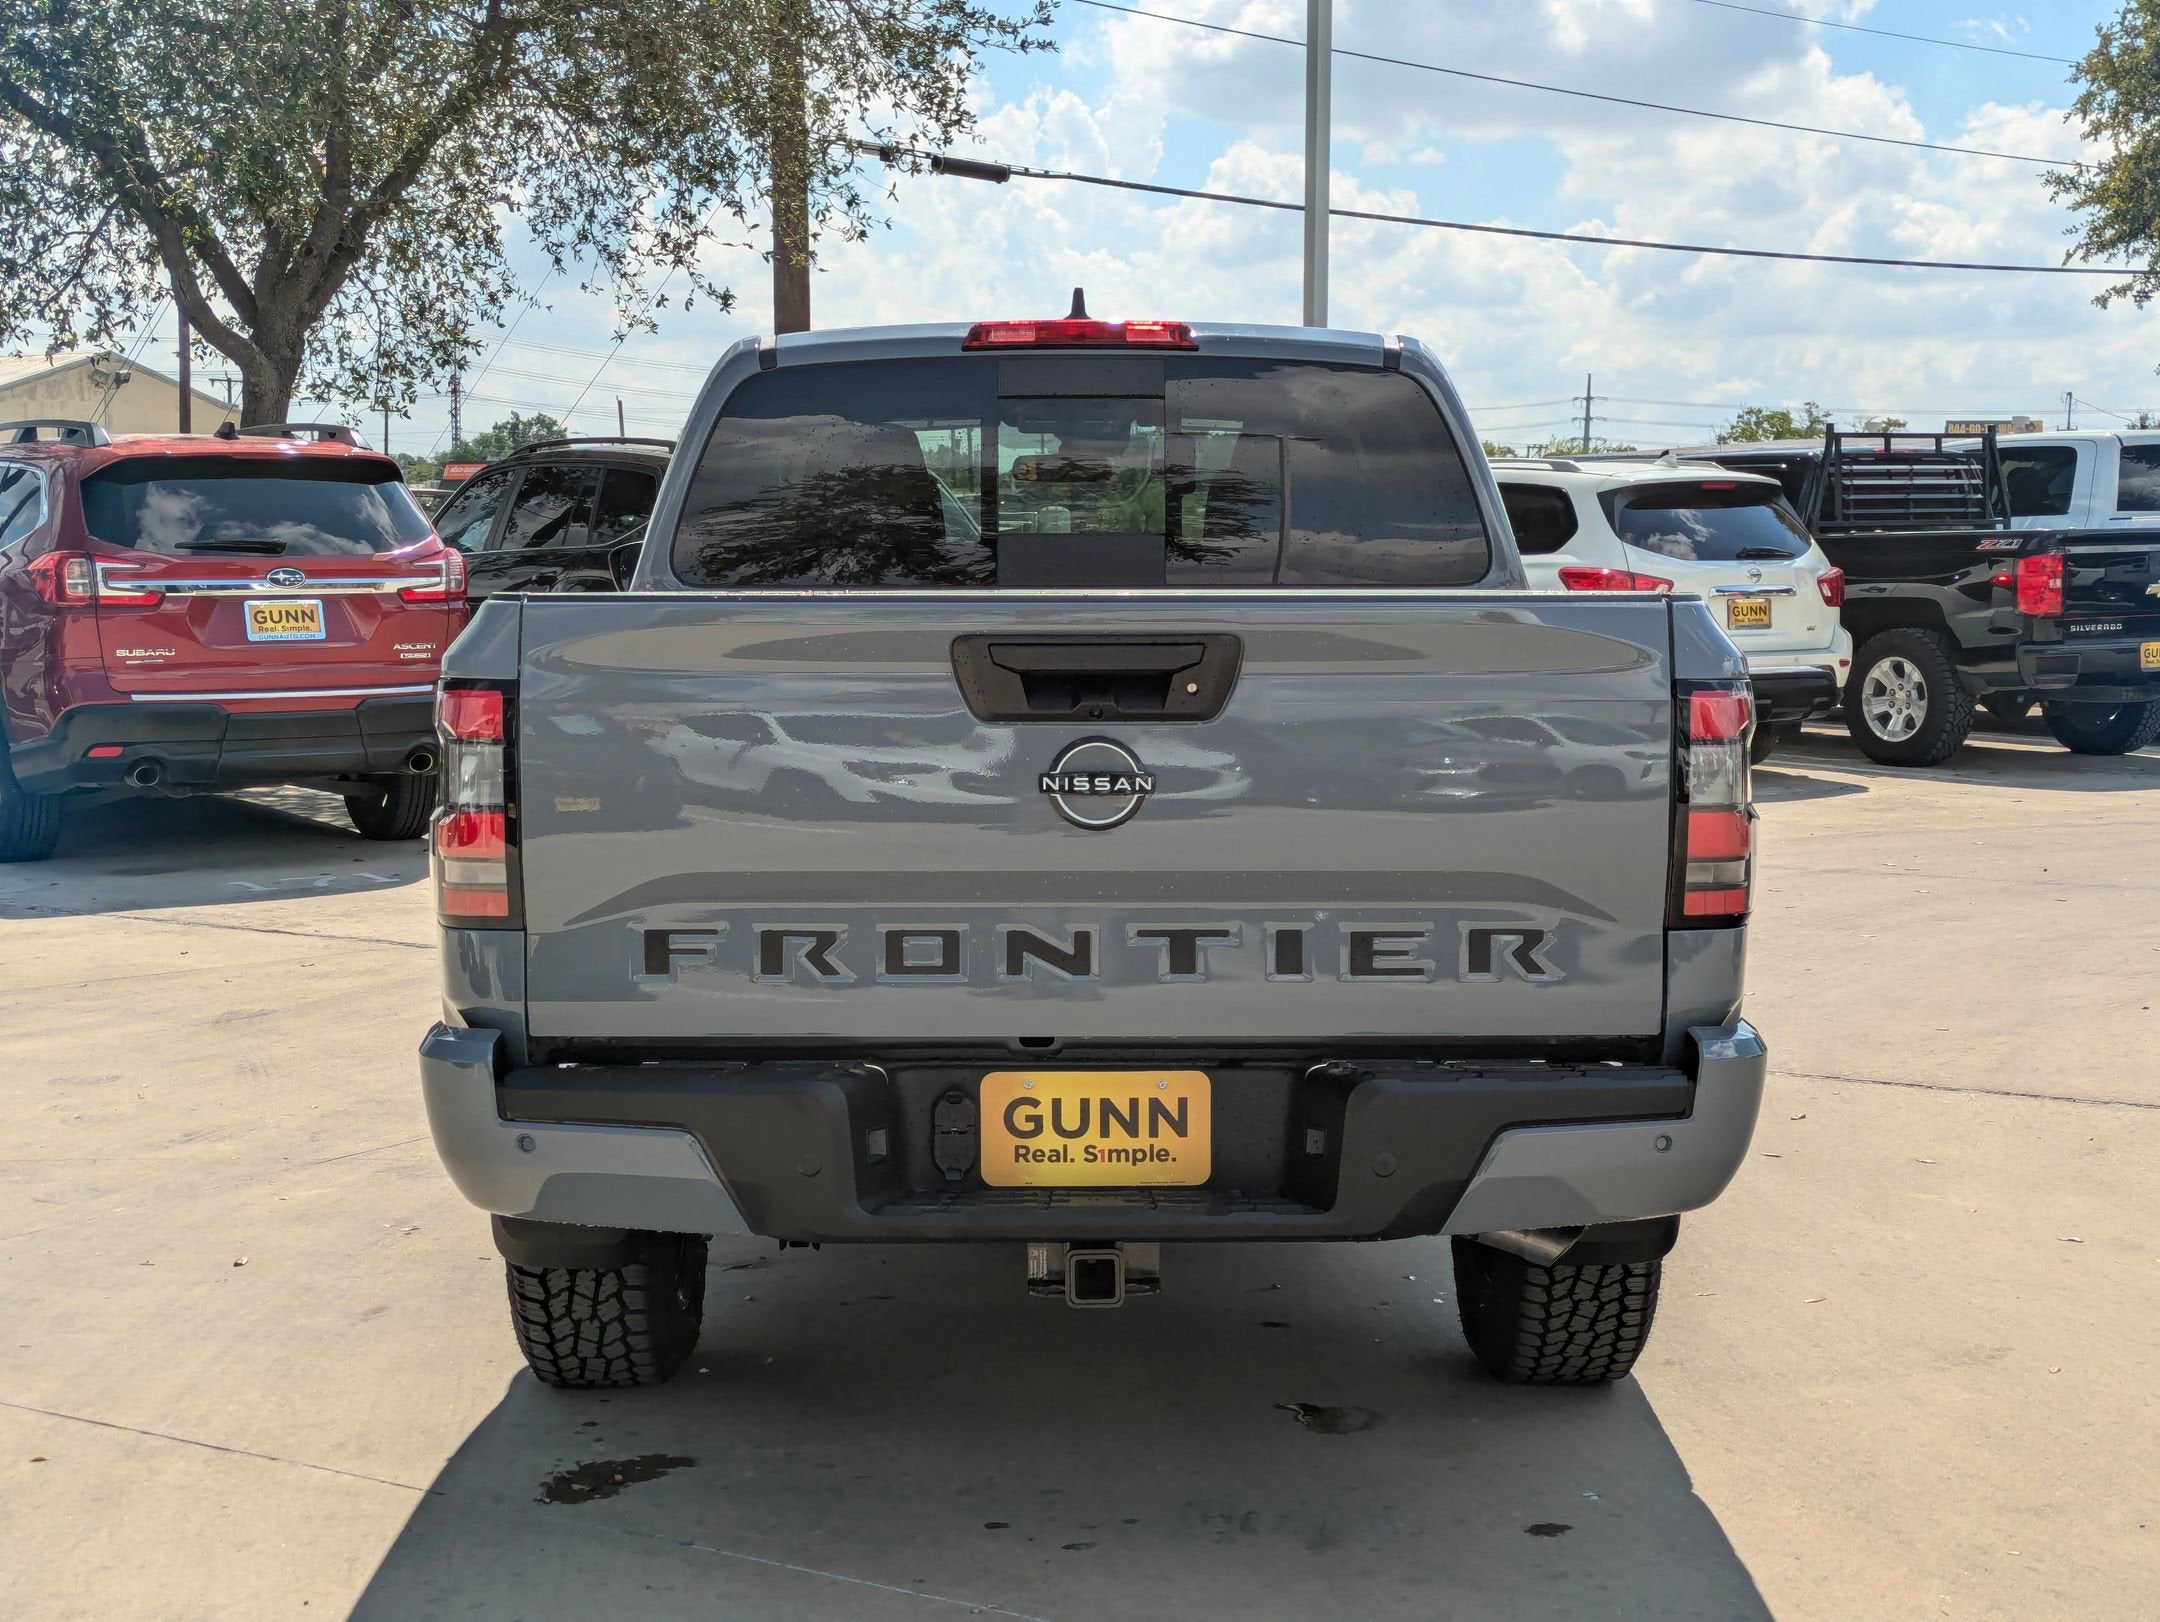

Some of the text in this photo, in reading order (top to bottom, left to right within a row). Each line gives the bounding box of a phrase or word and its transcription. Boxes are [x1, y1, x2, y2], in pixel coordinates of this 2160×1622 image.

[253, 609, 315, 624] GUNN
[1732, 605, 1767, 617] GUNN
[2070, 623, 2122, 632] SILVERADO
[116, 648, 176, 657] SUBARU
[2144, 648, 2160, 659] GU
[1042, 777, 1152, 791] NISSAN
[638, 926, 1558, 980] FRONTIER
[1003, 1096, 1188, 1139] GUNN
[1014, 1144, 1075, 1163] Real.
